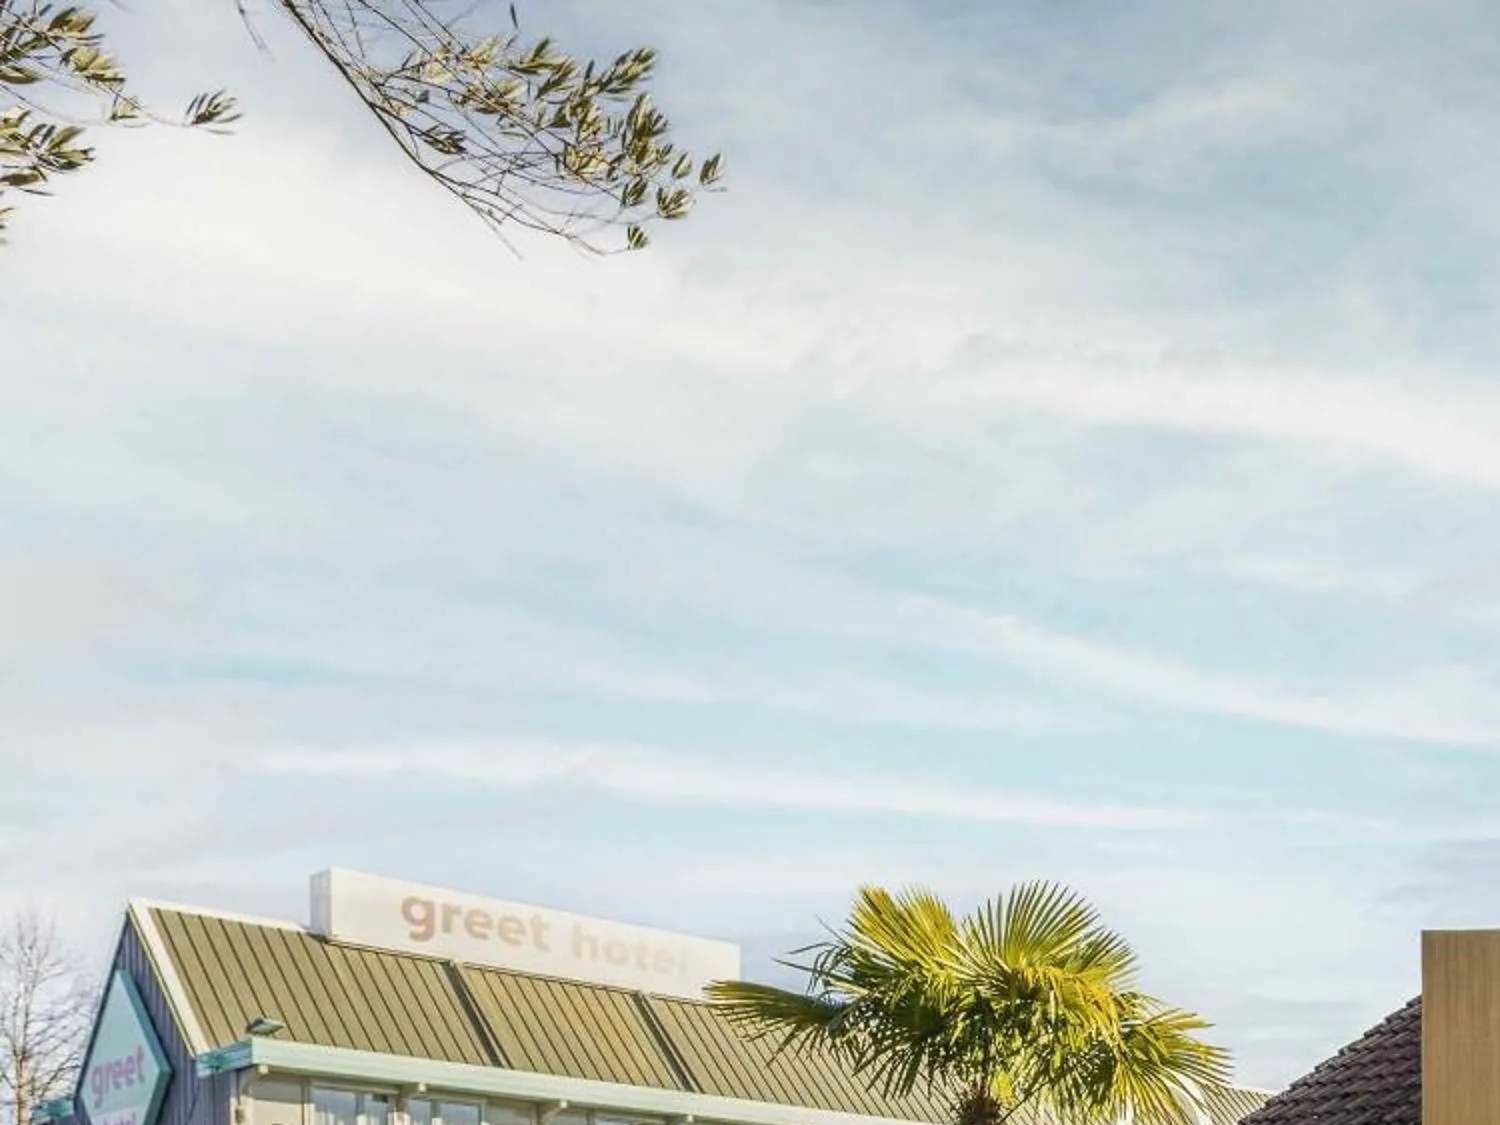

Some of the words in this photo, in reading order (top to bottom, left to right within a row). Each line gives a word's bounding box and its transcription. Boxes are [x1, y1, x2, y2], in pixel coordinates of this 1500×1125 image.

[401, 896, 549, 952] greet
[571, 921, 688, 976] hotel
[92, 1044, 146, 1109] greet
